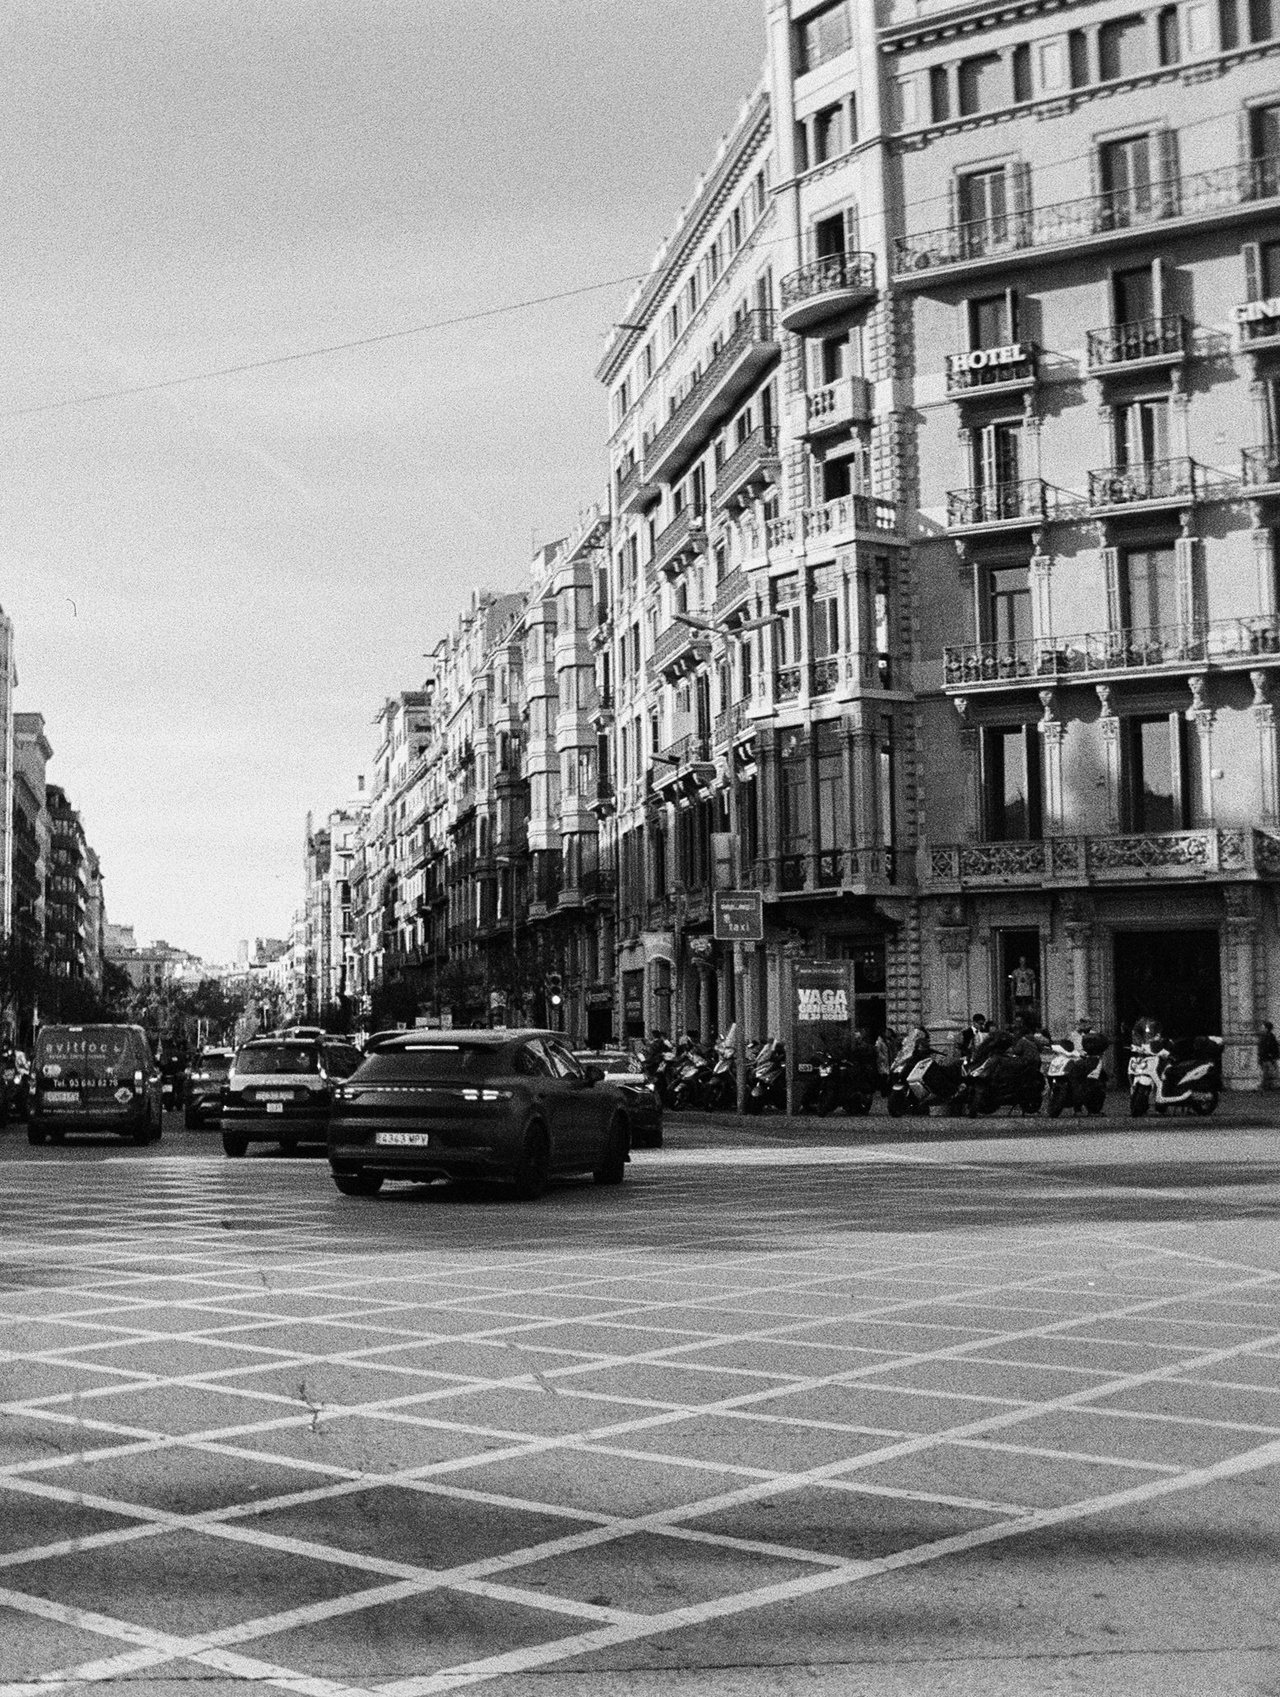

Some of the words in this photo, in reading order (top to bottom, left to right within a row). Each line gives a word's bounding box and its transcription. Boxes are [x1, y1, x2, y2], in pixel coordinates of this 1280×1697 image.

[950, 343, 1027, 373] HOTEL
[797, 988, 848, 1005] VAGA
[798, 1004, 847, 1014] GENERAL
